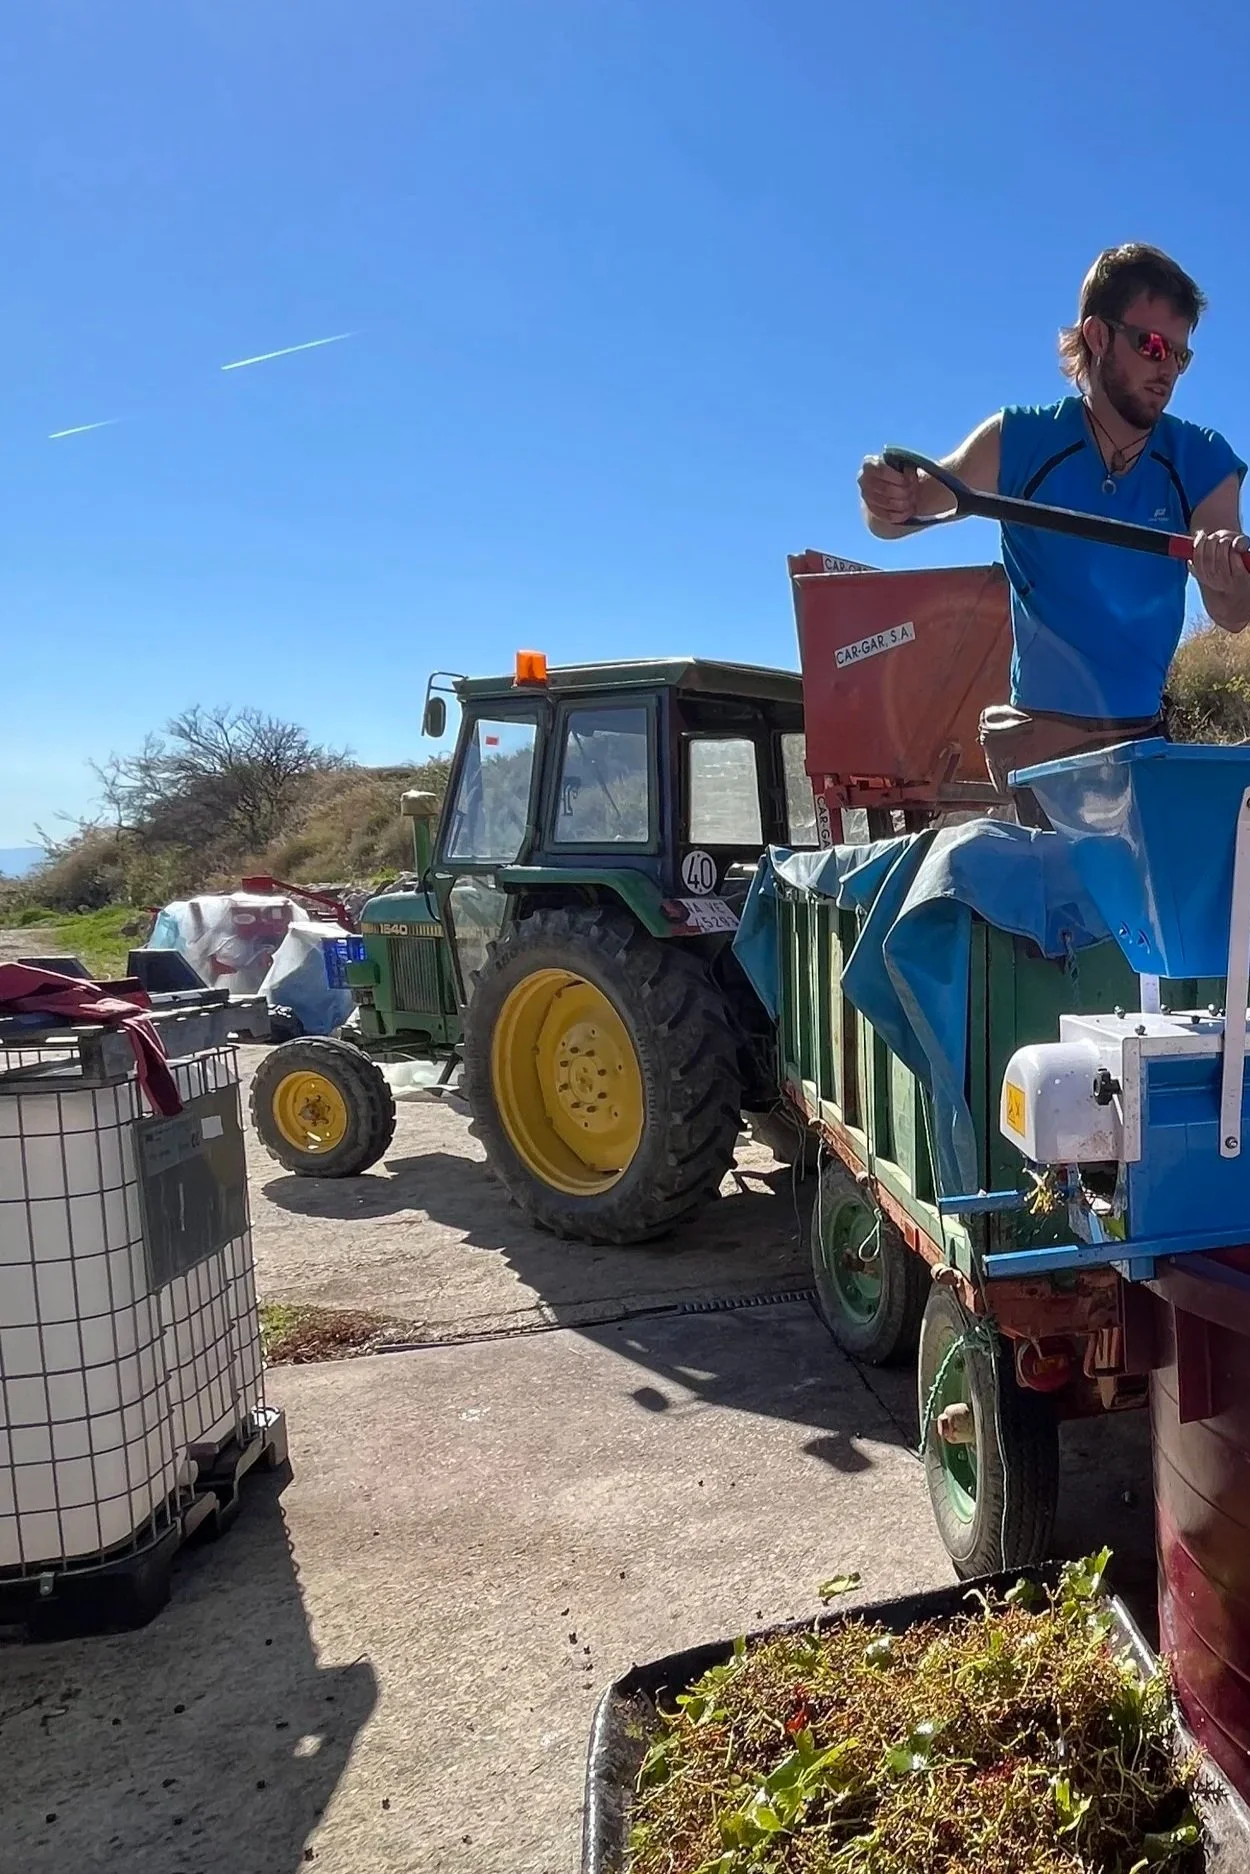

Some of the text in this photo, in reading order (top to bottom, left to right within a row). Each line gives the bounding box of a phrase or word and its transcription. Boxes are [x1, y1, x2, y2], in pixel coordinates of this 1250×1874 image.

[836, 626, 913, 665] CAR-GAR, S.A.
[816, 796, 832, 849] CAR-GA
[686, 854, 714, 889] 40
